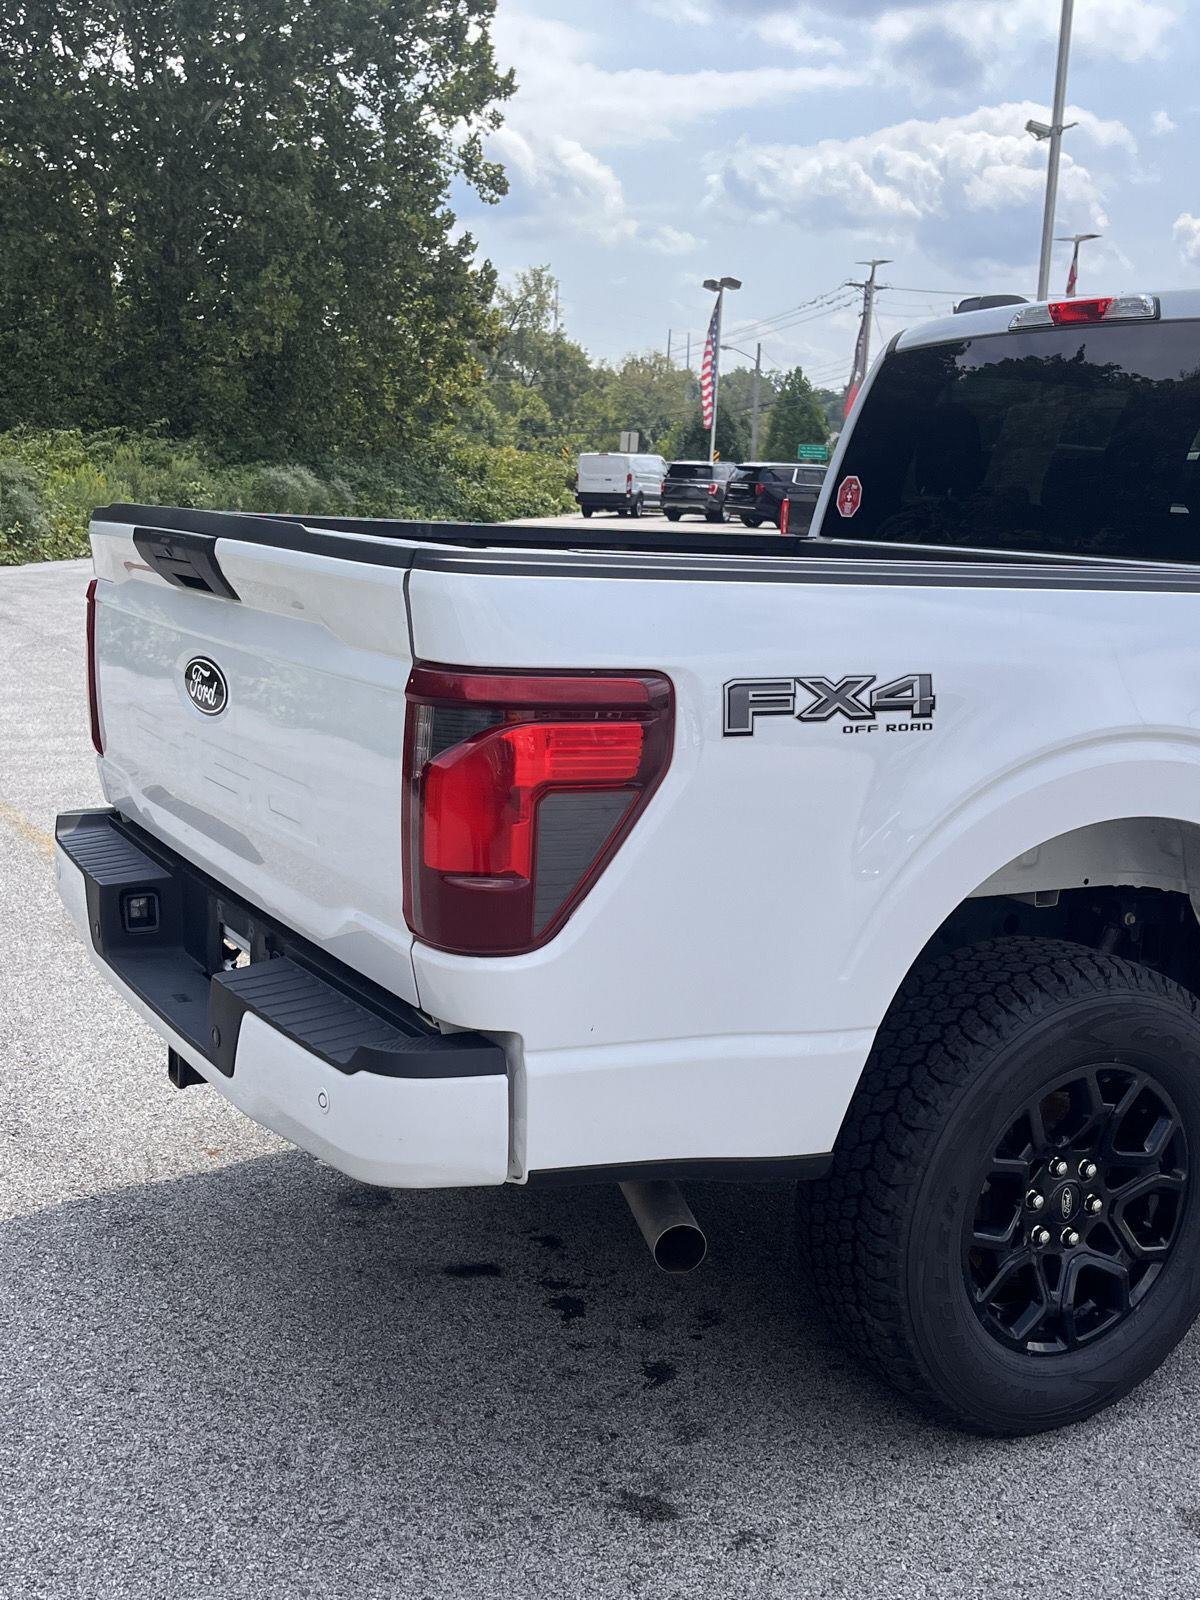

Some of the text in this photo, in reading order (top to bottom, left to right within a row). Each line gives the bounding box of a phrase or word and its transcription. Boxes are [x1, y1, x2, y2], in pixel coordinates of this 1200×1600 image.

[189, 664, 218, 706] Ford
[723, 674, 935, 737] FX4
[843, 722, 933, 734] OFF ROAD
